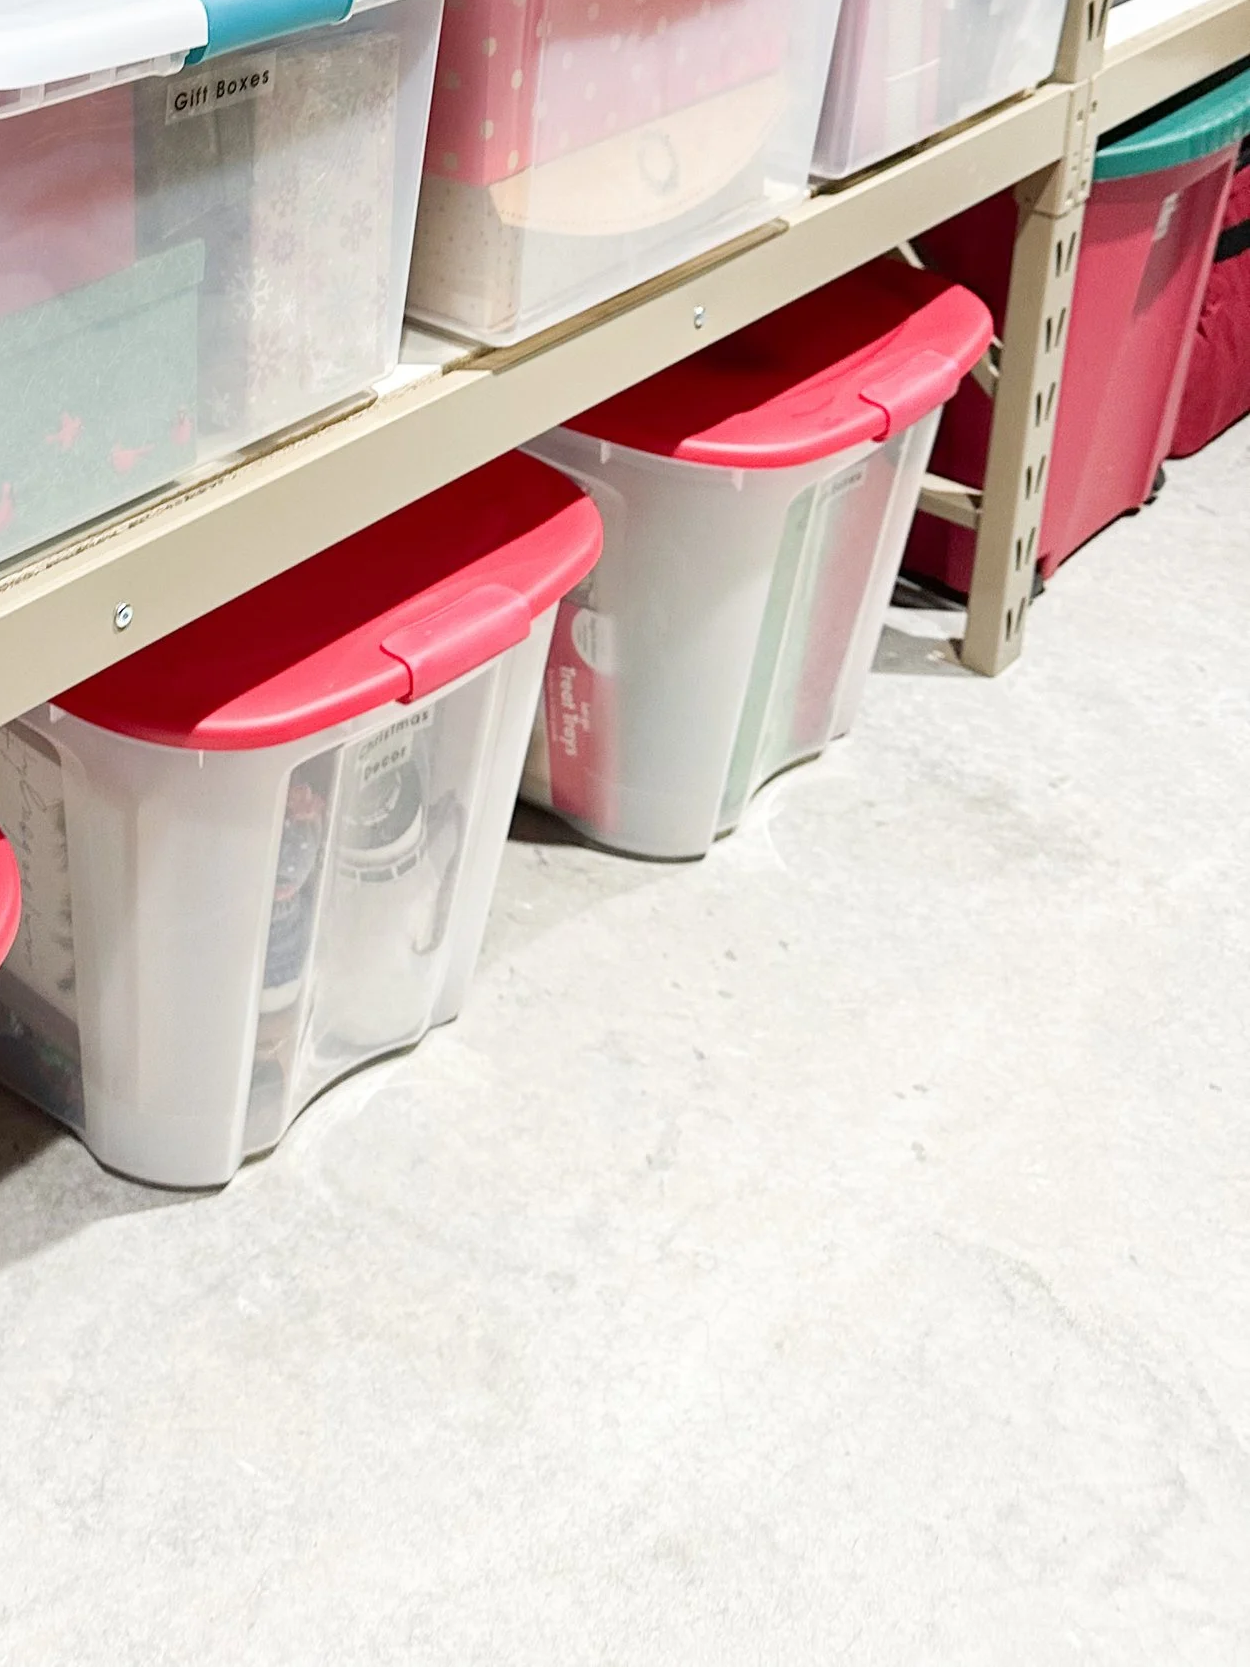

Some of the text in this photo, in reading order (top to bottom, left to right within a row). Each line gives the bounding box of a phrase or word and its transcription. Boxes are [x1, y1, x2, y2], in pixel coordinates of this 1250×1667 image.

[174, 69, 270, 111] Gift Boxes
[357, 710, 429, 761] Christmas
[363, 744, 407, 781] Decor
